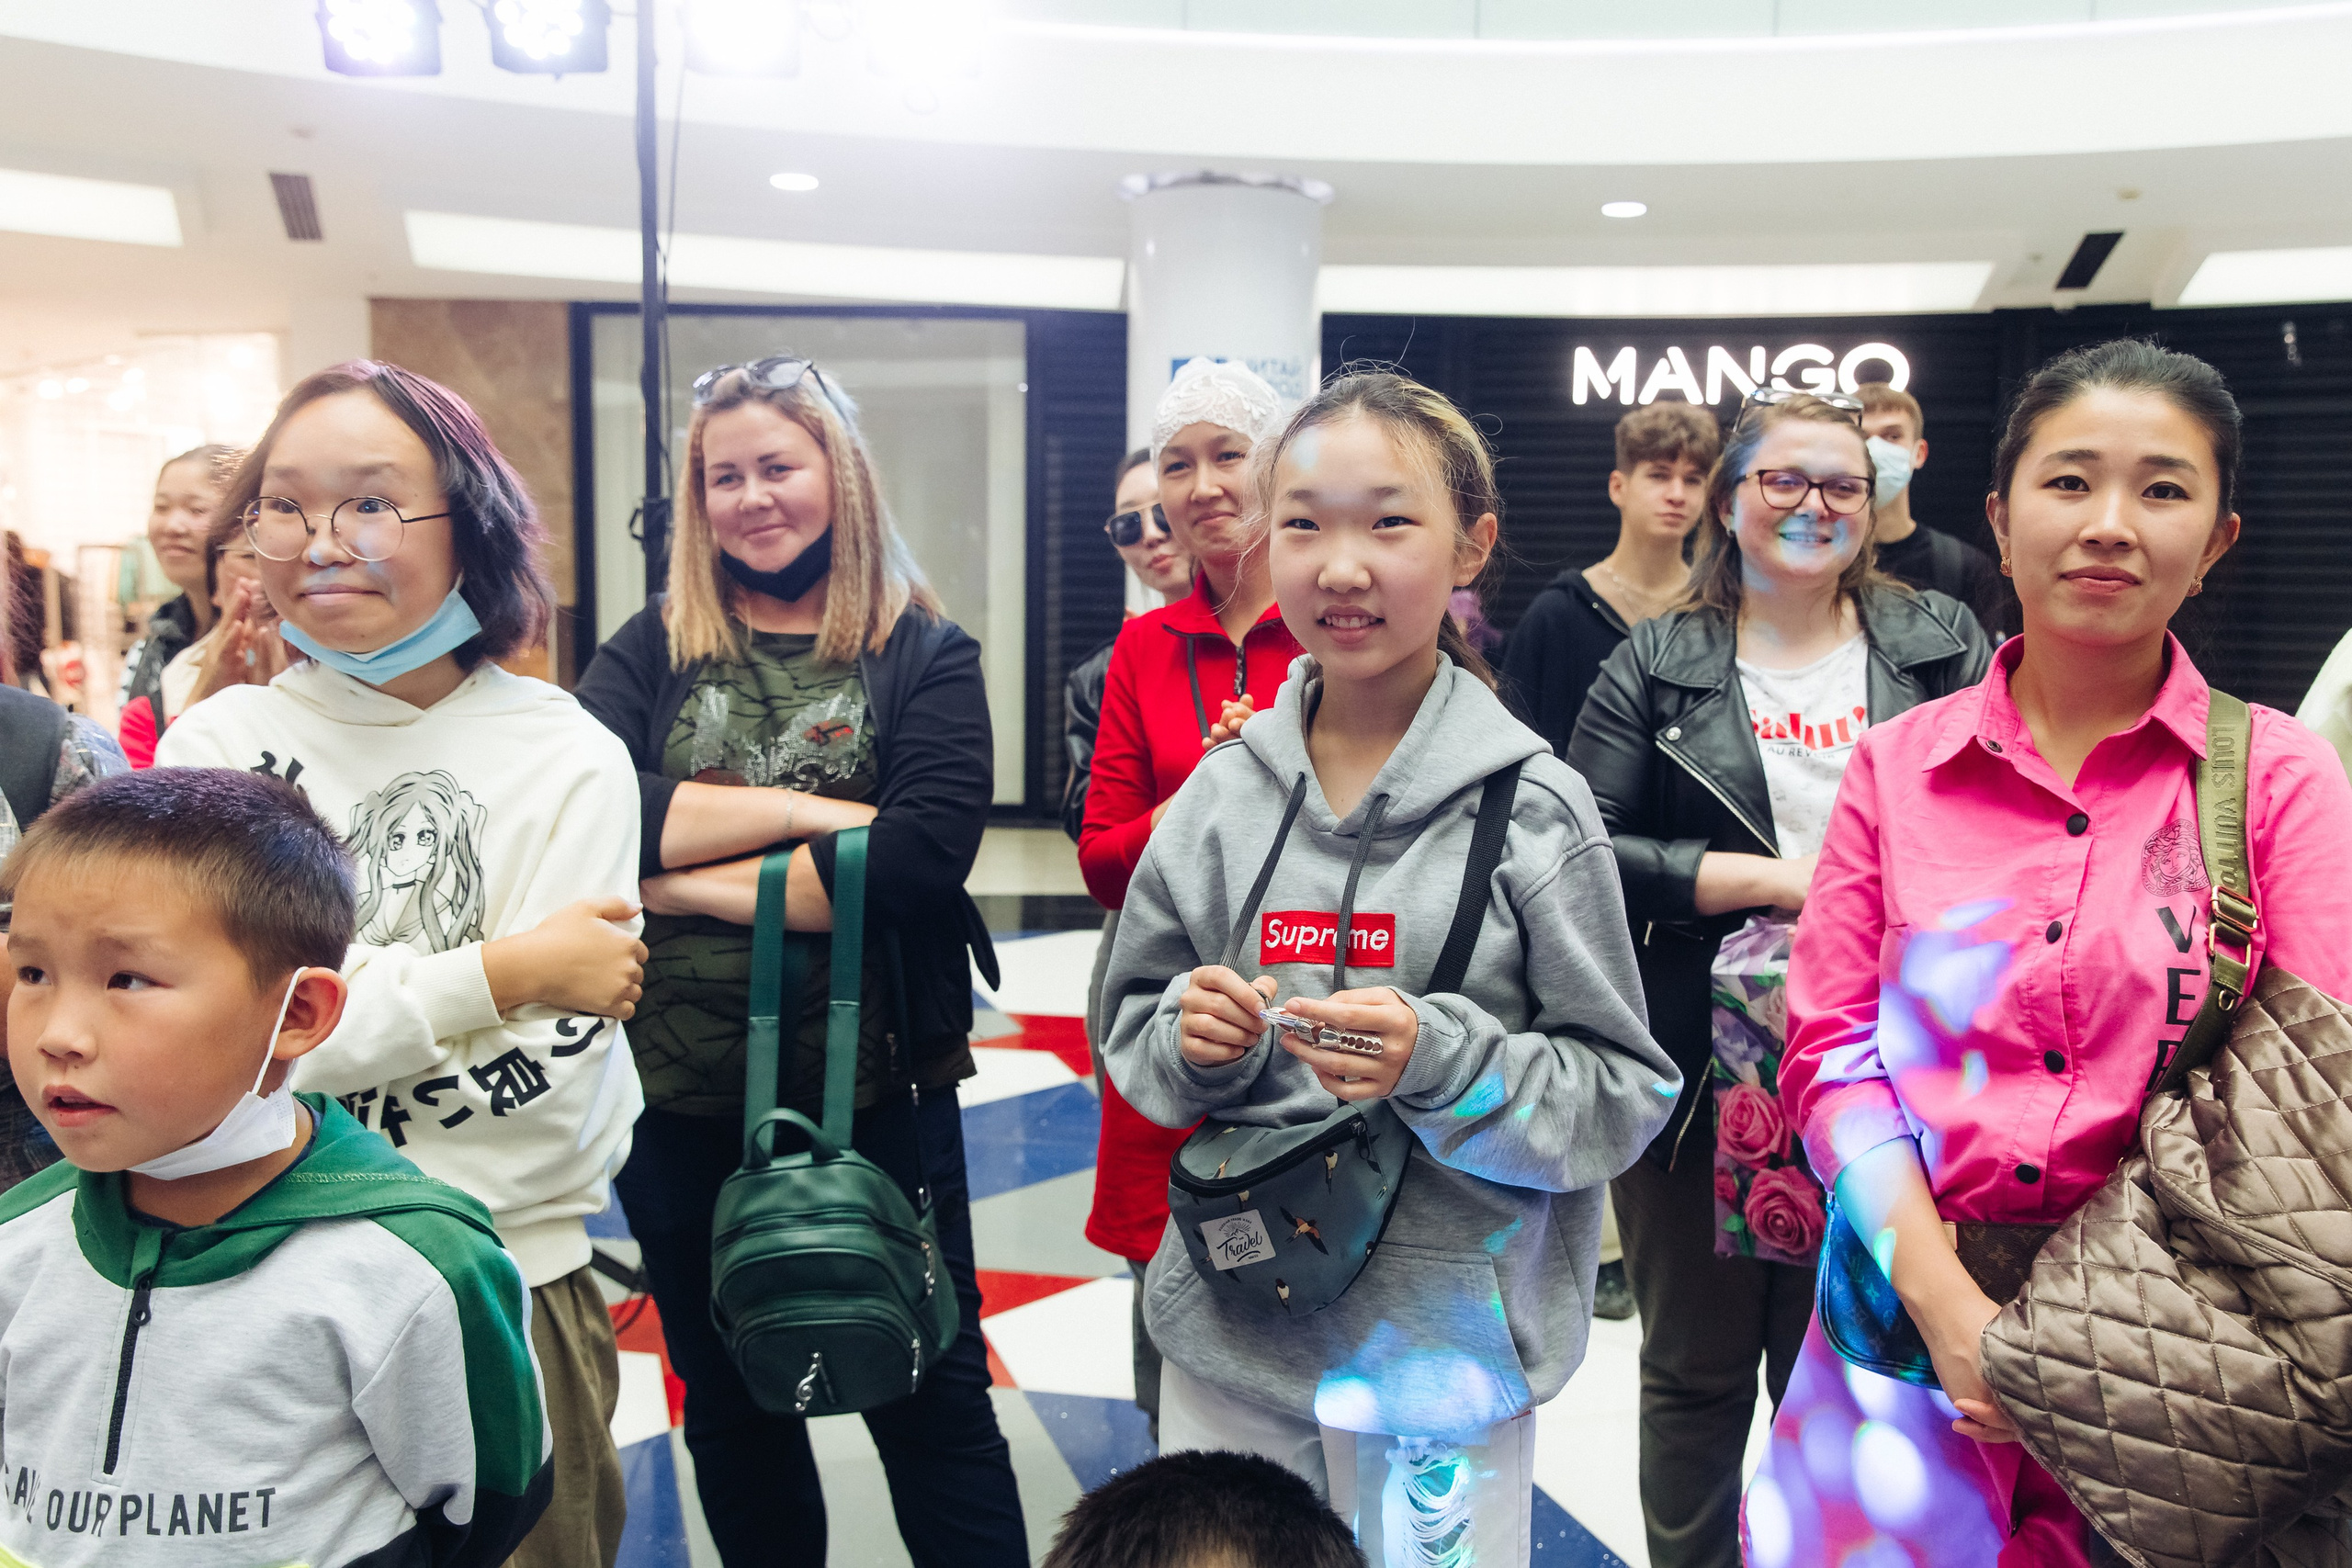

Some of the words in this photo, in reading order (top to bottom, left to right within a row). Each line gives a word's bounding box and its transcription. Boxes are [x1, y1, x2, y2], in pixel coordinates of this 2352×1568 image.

[1572, 343, 1910, 405] MANGO
[2211, 724, 2235, 789] LOUIS
[1265, 919, 1389, 953] Suprme
[1216, 1231, 1263, 1261] Travel
[47, 1488, 113, 1538] OUR
[119, 1487, 276, 1537] PLANET
